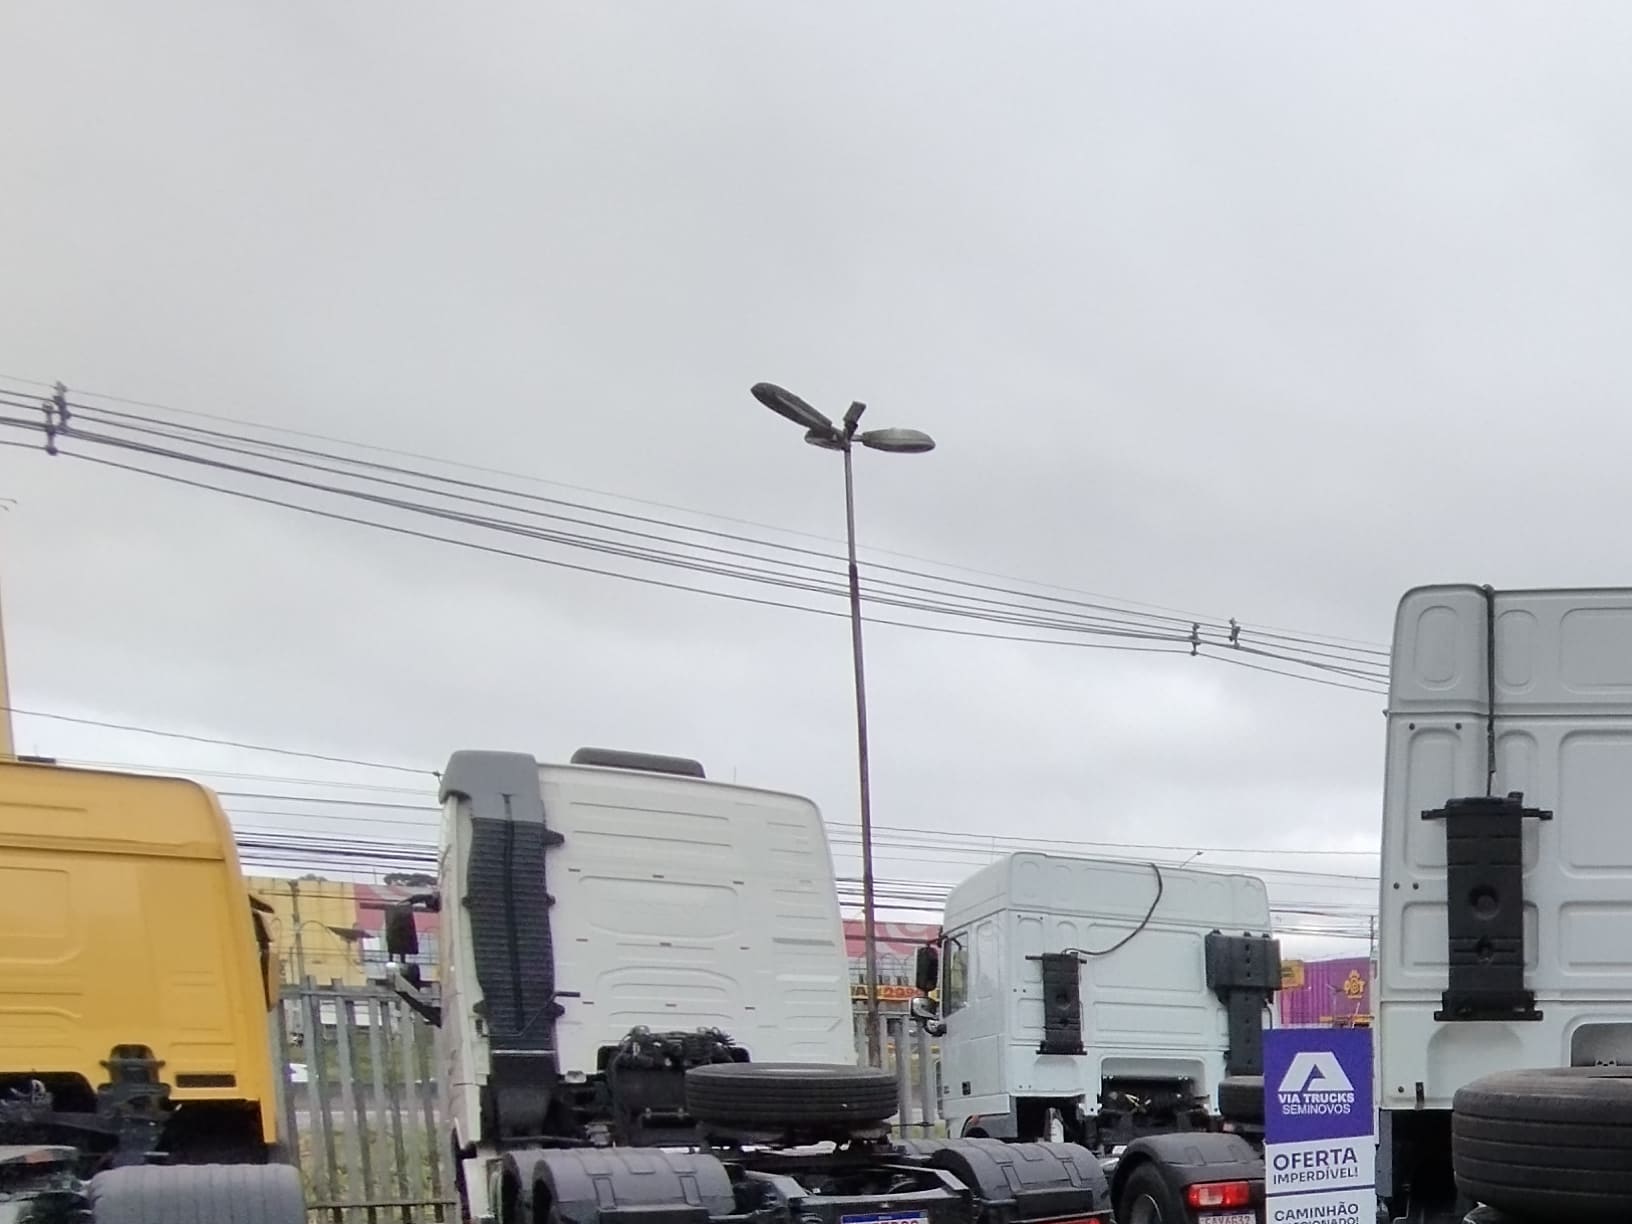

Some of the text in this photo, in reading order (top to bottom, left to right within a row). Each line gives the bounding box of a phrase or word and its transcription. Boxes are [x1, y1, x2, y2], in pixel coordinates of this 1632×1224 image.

[1278, 1093, 1355, 1104] VIA TRUCKS
[1282, 1104, 1351, 1115] SEMINOVOS
[1273, 1148, 1358, 1171] OFERTA
[1273, 1166, 1359, 1185] IMPERDÍVEL!
[1274, 1202, 1359, 1222] CAMINHÃO
